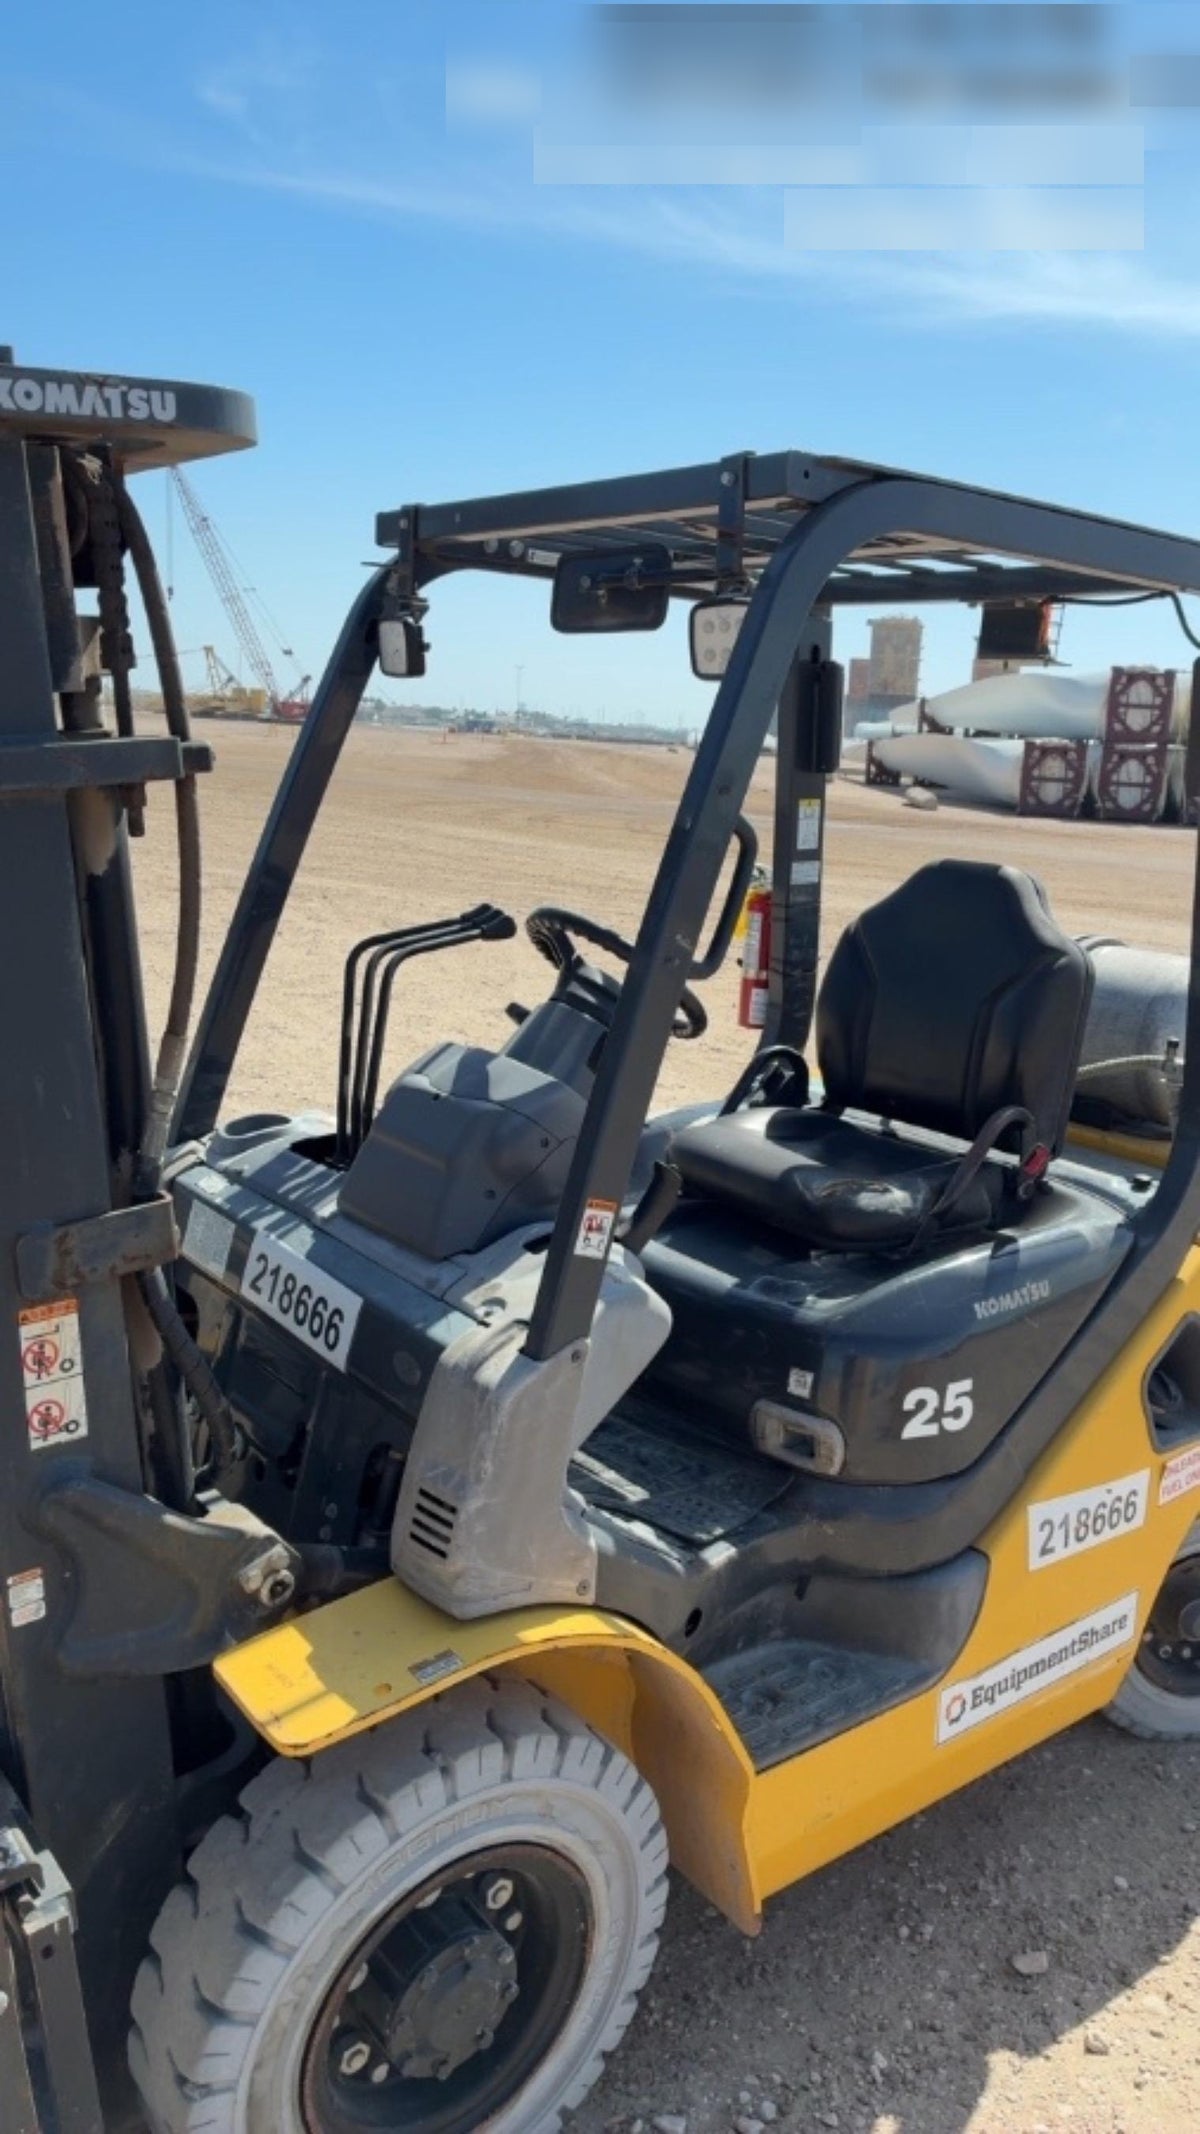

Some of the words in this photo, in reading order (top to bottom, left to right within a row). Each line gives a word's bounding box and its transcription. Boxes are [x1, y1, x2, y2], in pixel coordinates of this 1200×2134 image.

[249, 1253, 345, 1352] 218666
[974, 1280, 1050, 1320] KOMATSU
[901, 1377, 974, 1440] 25
[1038, 1489, 1139, 1558] 218666
[970, 1613, 1129, 1710] EquipmentShare
